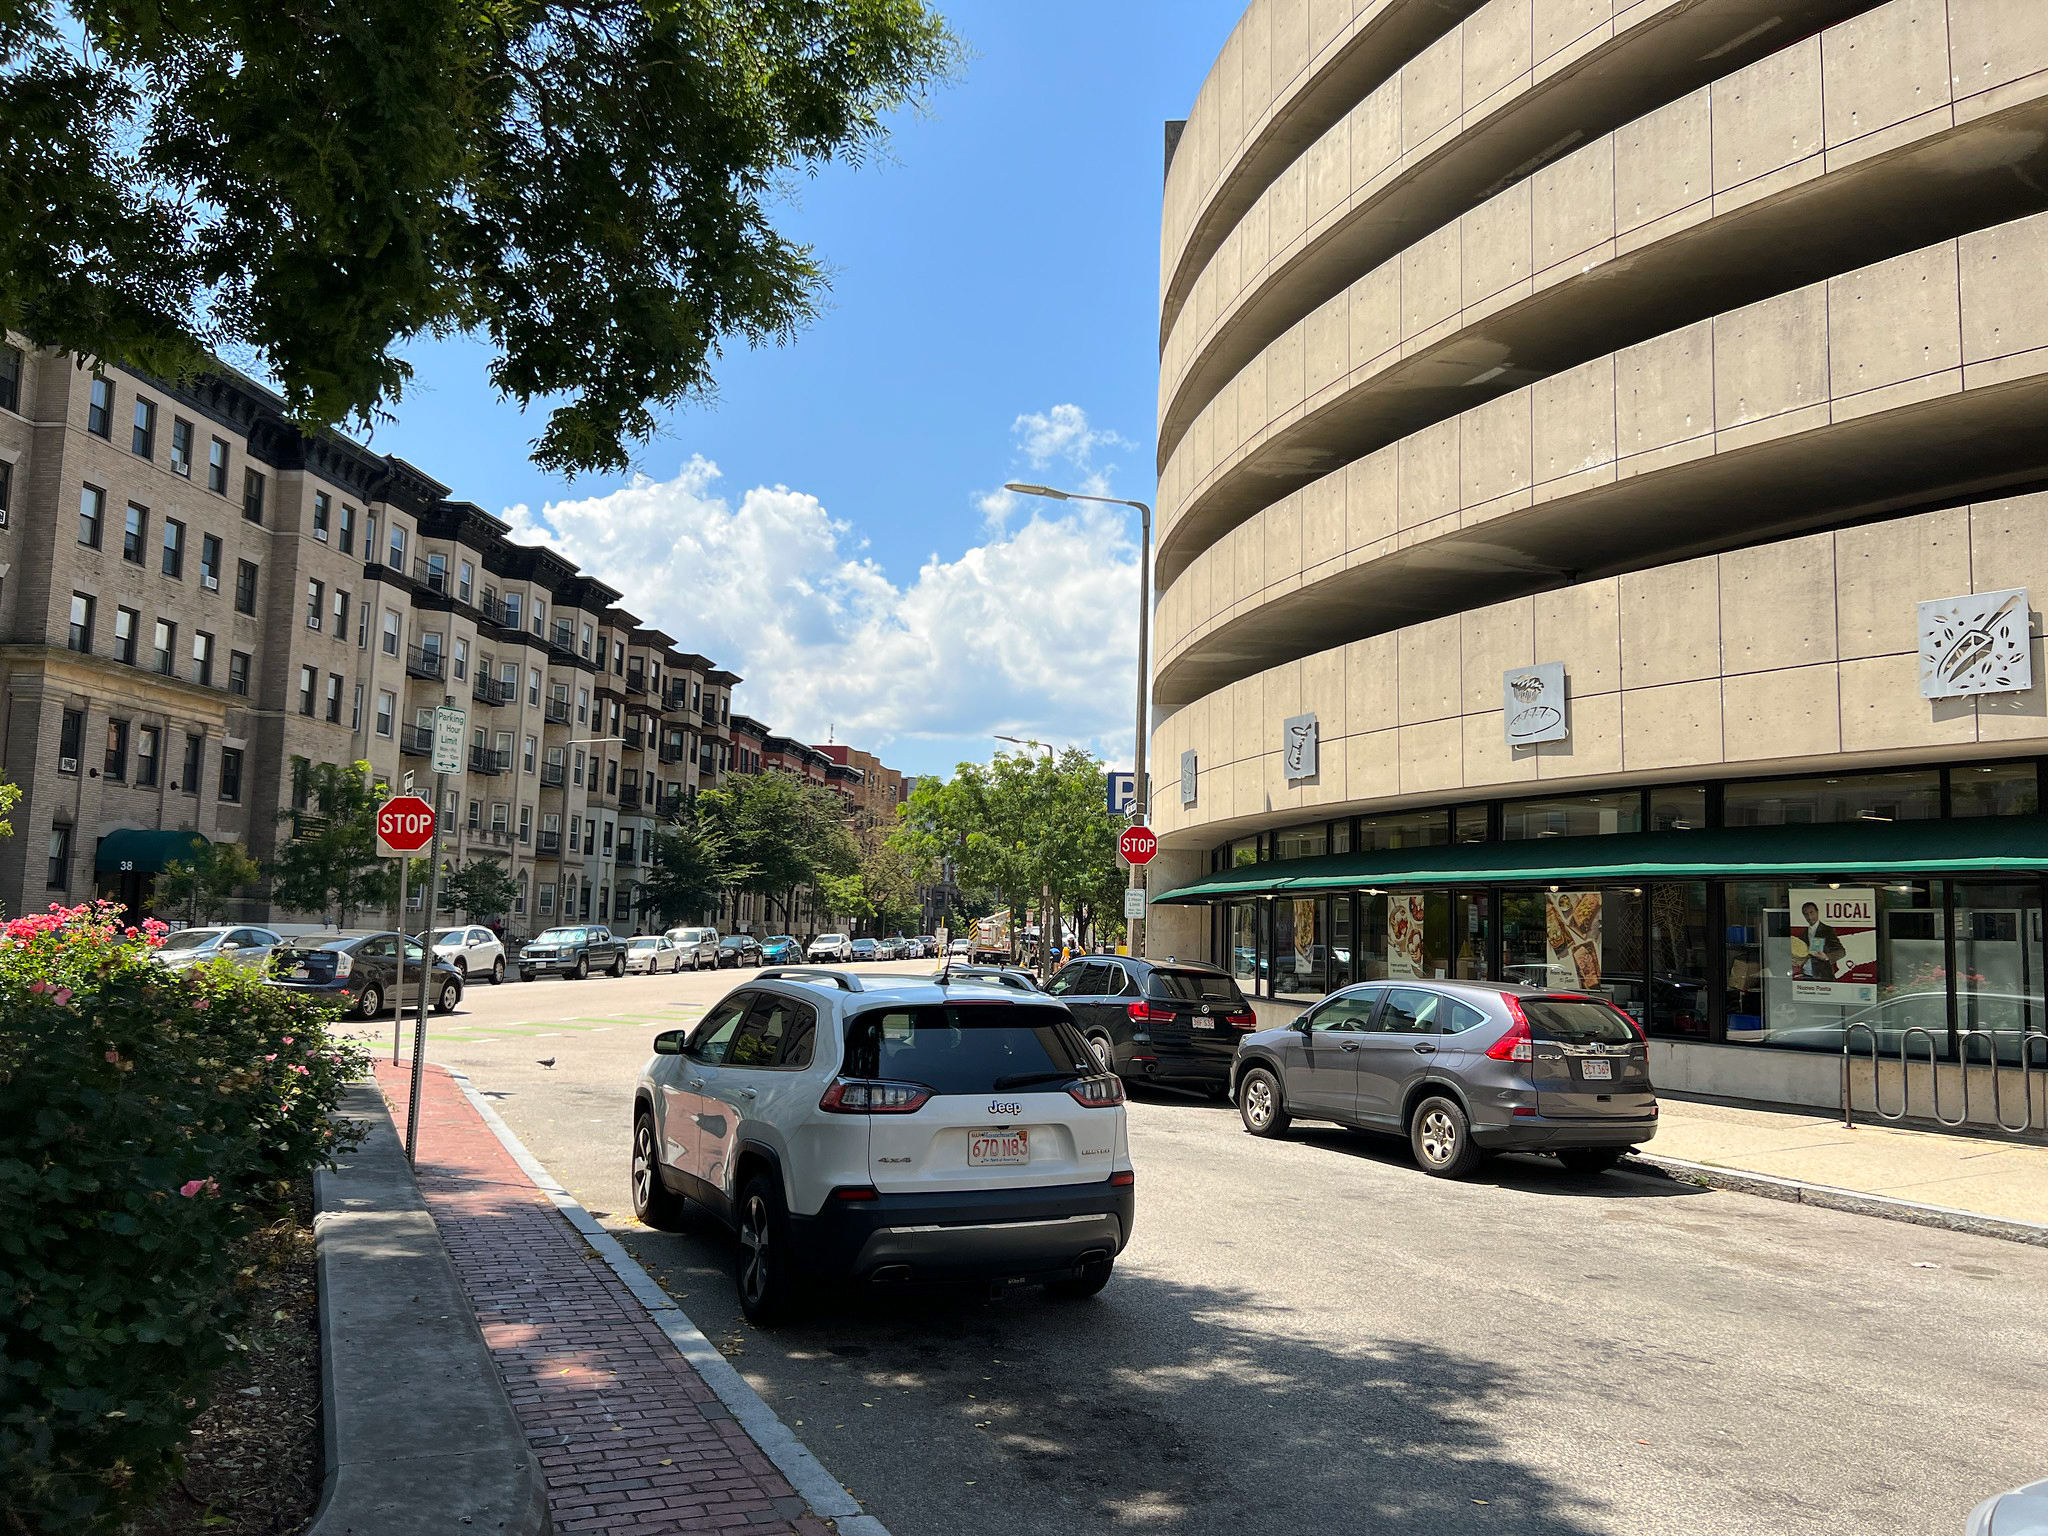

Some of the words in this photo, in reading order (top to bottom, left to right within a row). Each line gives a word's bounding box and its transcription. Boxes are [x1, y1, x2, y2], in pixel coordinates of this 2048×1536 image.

[439, 712, 464, 726] Parking
[446, 724, 461, 734] Hour
[441, 735, 457, 745] Limit
[381, 814, 432, 834] STOP
[1122, 838, 1155, 853] STOP
[120, 861, 133, 871] 38
[1826, 903, 1871, 918] LOCAL
[987, 1100, 1022, 1116] Jeep
[1002, 1138, 1028, 1156] N83
